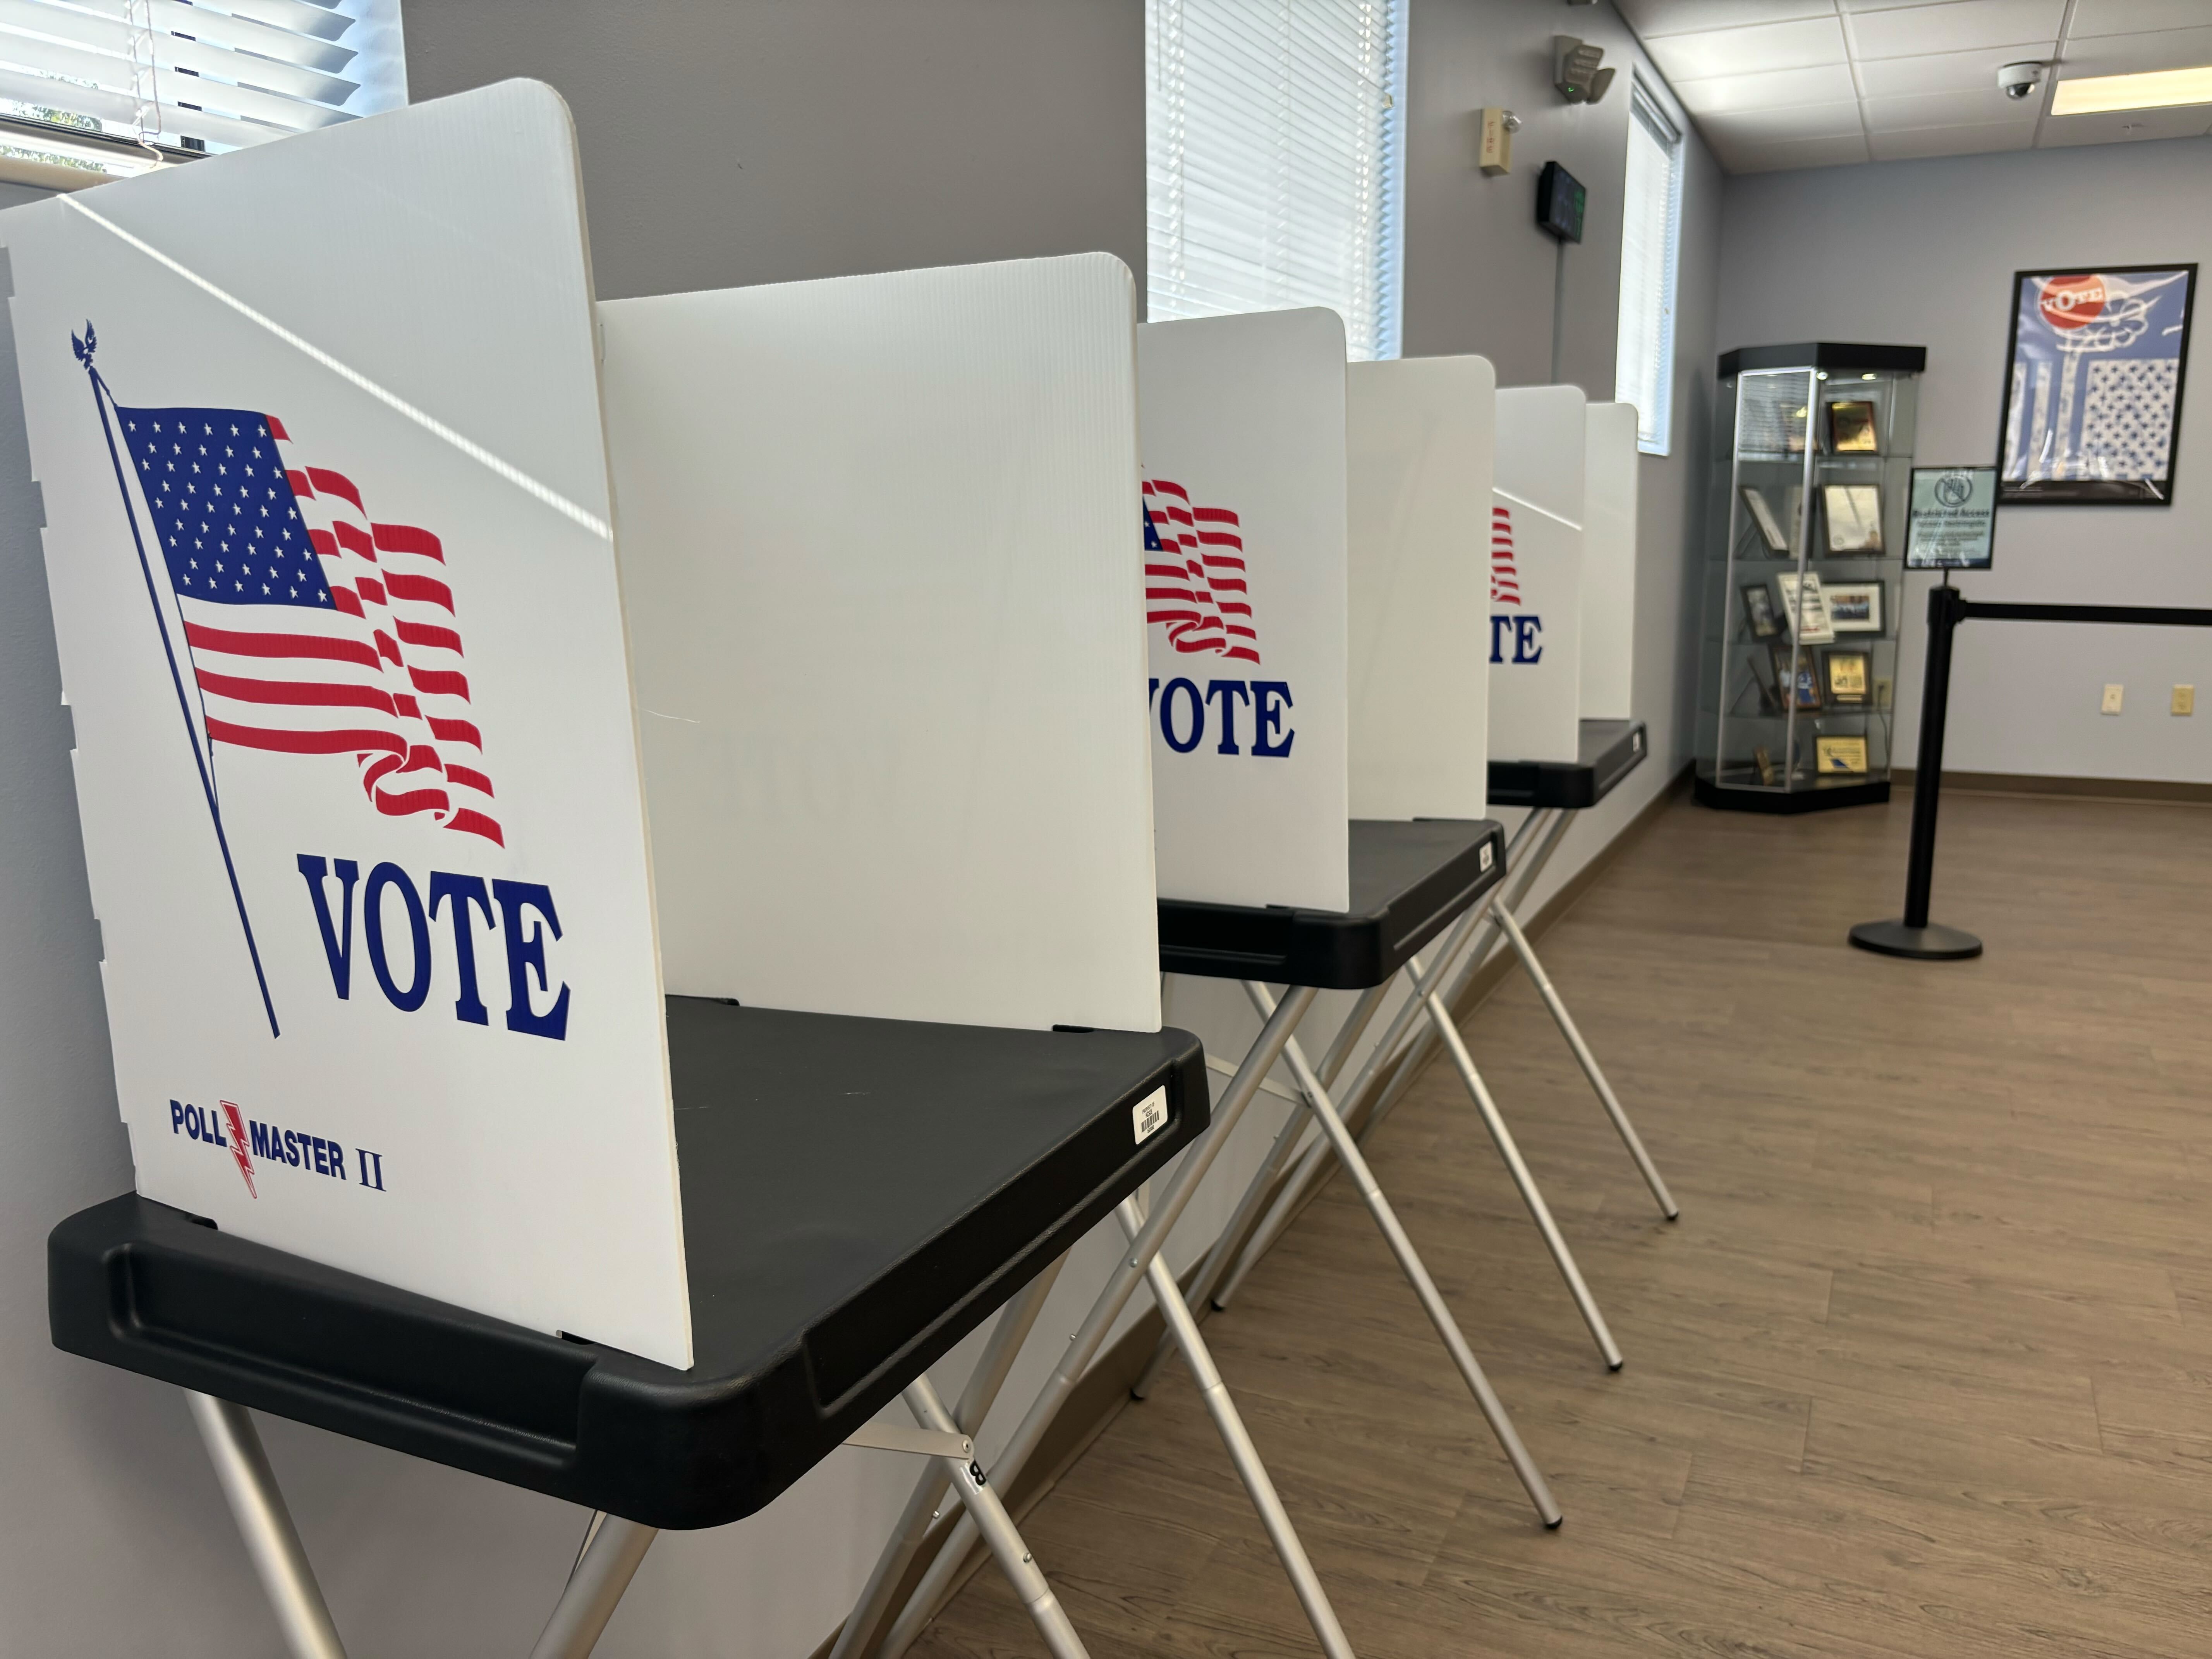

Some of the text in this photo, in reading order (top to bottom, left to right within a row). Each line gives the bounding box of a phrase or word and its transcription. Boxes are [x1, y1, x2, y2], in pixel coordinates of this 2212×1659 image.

[2039, 287, 2103, 311] VOTE
[1489, 616, 1542, 663] TE
[297, 853, 571, 1041] VOTE
[170, 1099, 387, 1192] POLL MASTER II
[969, 1459, 987, 1486] B
